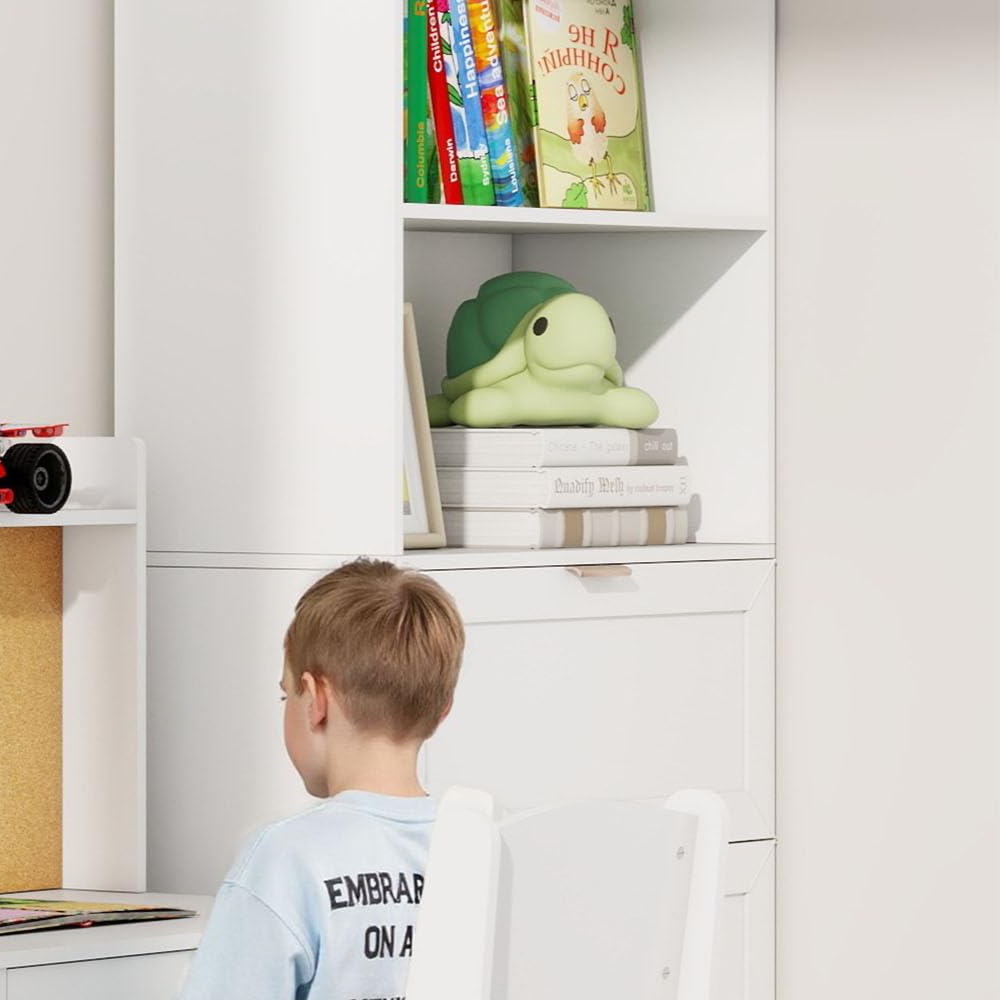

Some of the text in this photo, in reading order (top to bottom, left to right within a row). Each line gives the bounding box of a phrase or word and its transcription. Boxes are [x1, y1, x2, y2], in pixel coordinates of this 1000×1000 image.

[495, 85, 508, 126] Sea
[446, 138, 458, 183] Darwin
[364, 925, 413, 960] ON A
